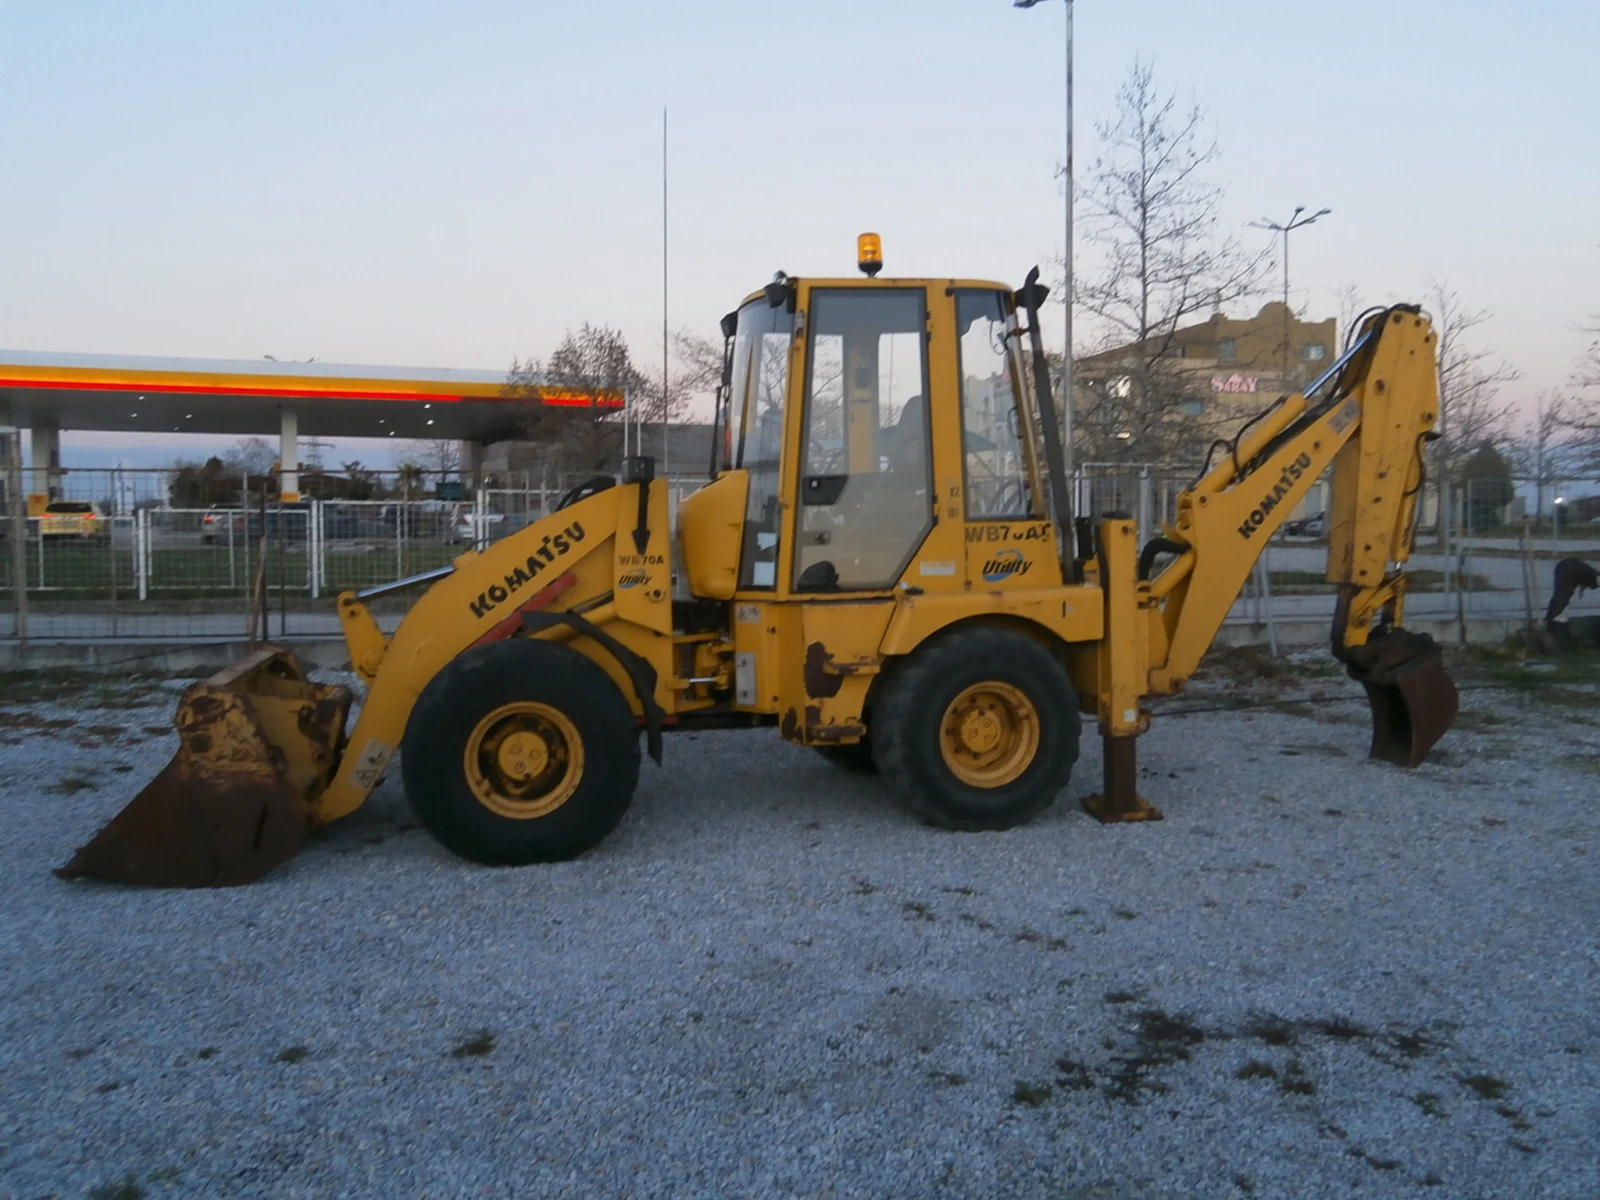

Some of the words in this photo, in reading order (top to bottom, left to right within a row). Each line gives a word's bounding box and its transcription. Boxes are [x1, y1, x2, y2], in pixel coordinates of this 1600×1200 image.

[1210, 374, 1259, 392] SARAY
[1237, 452, 1312, 540] KOMATSU
[618, 555, 665, 566] WB70A
[982, 557, 1034, 576] Utility
[469, 521, 586, 619] KOMATSU
[618, 574, 653, 586] Utility
